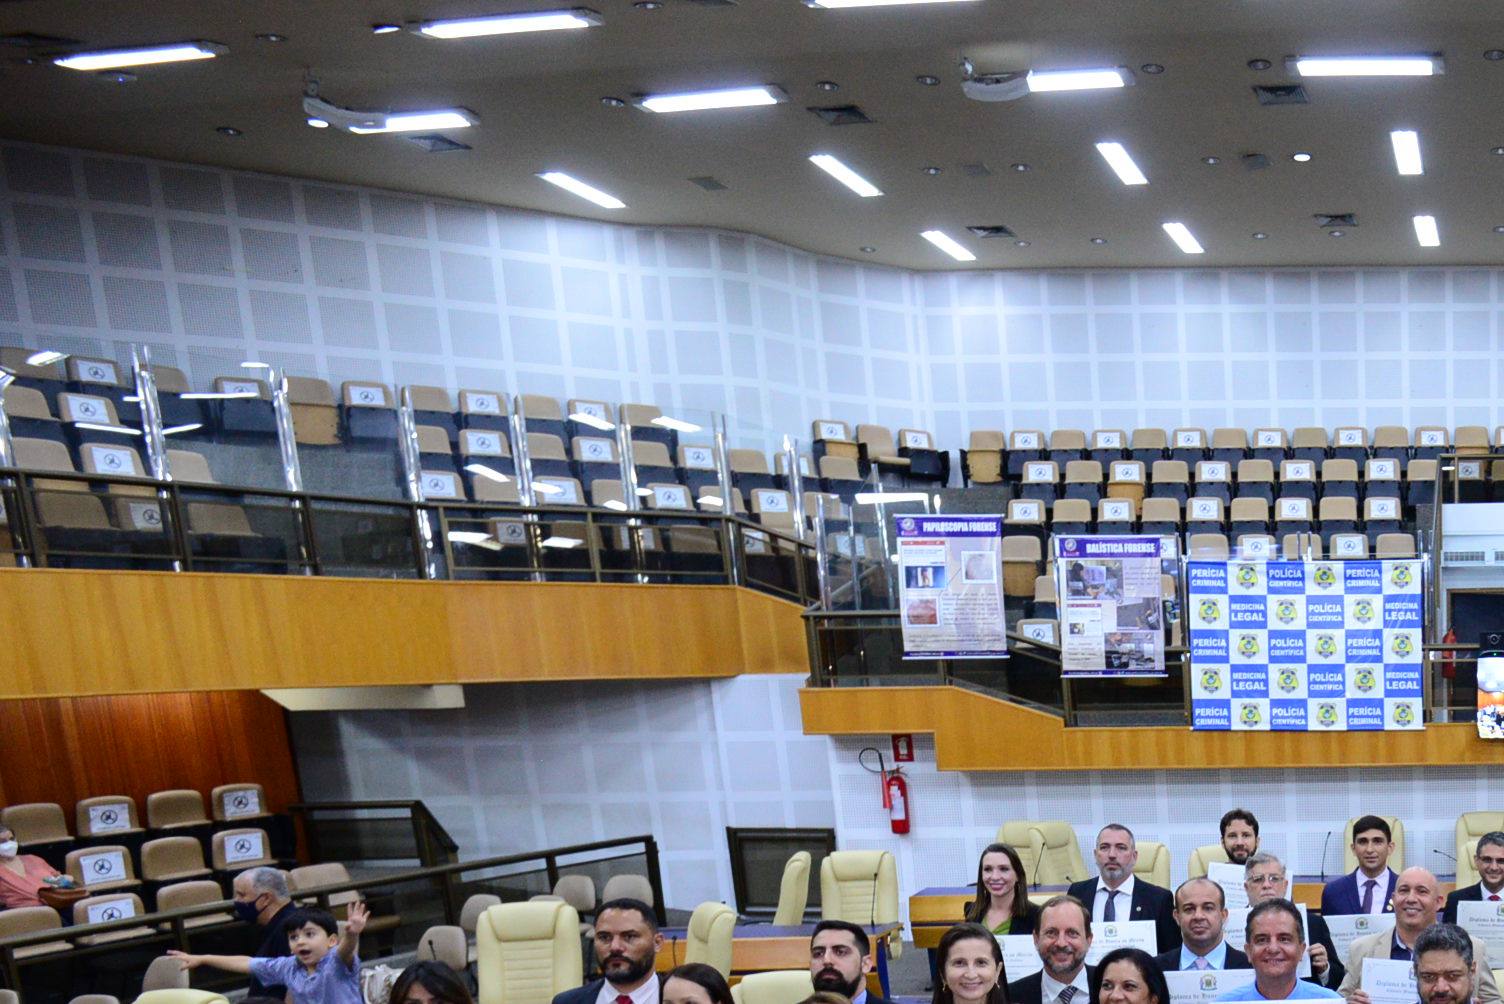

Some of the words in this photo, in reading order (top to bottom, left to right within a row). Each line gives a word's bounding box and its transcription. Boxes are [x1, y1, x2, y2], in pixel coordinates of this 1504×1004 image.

[923, 522, 969, 532] PAPILOSCOPIA
[970, 522, 997, 532] FORENSE
[1086, 542, 1123, 553] BALÍSTICA
[1124, 543, 1155, 553] FORENSE
[1192, 568, 1225, 578] PERÍCIA
[1269, 568, 1302, 578] POLÍCIA
[1346, 568, 1379, 578] PERÍCIA
[1269, 579, 1303, 587] CIENTÍFICA
[1346, 579, 1380, 587] CRIMINAL
[1231, 603, 1264, 611] MEDICINA
[1308, 603, 1341, 613] POLÍCIA
[1385, 602, 1418, 610] MEDICINA
[1231, 612, 1265, 621] LEGAL
[1309, 614, 1342, 622] CIENTÍFICA
[1385, 611, 1418, 620] LEGAL
[1193, 637, 1226, 647] PERÍCIA
[1270, 637, 1304, 647] POLÍCIA
[1348, 637, 1381, 647] PERÍCIA
[1271, 648, 1304, 656] CIENTÍFICA
[1348, 648, 1381, 656] CRIMINAL
[1233, 672, 1266, 680] MEDICINA
[1310, 672, 1343, 682] POLÍCIA
[1386, 671, 1419, 679] MEDICINA
[1233, 681, 1267, 690] LEGAL
[1310, 683, 1343, 691] CIENTÍFICA
[1386, 680, 1419, 690] LEGAL
[1195, 707, 1228, 717] PERÍCIA
[1272, 707, 1305, 717] POLÍCIA
[1349, 706, 1381, 716] PERÍCIA
[1349, 717, 1382, 725] CRIMINAL
